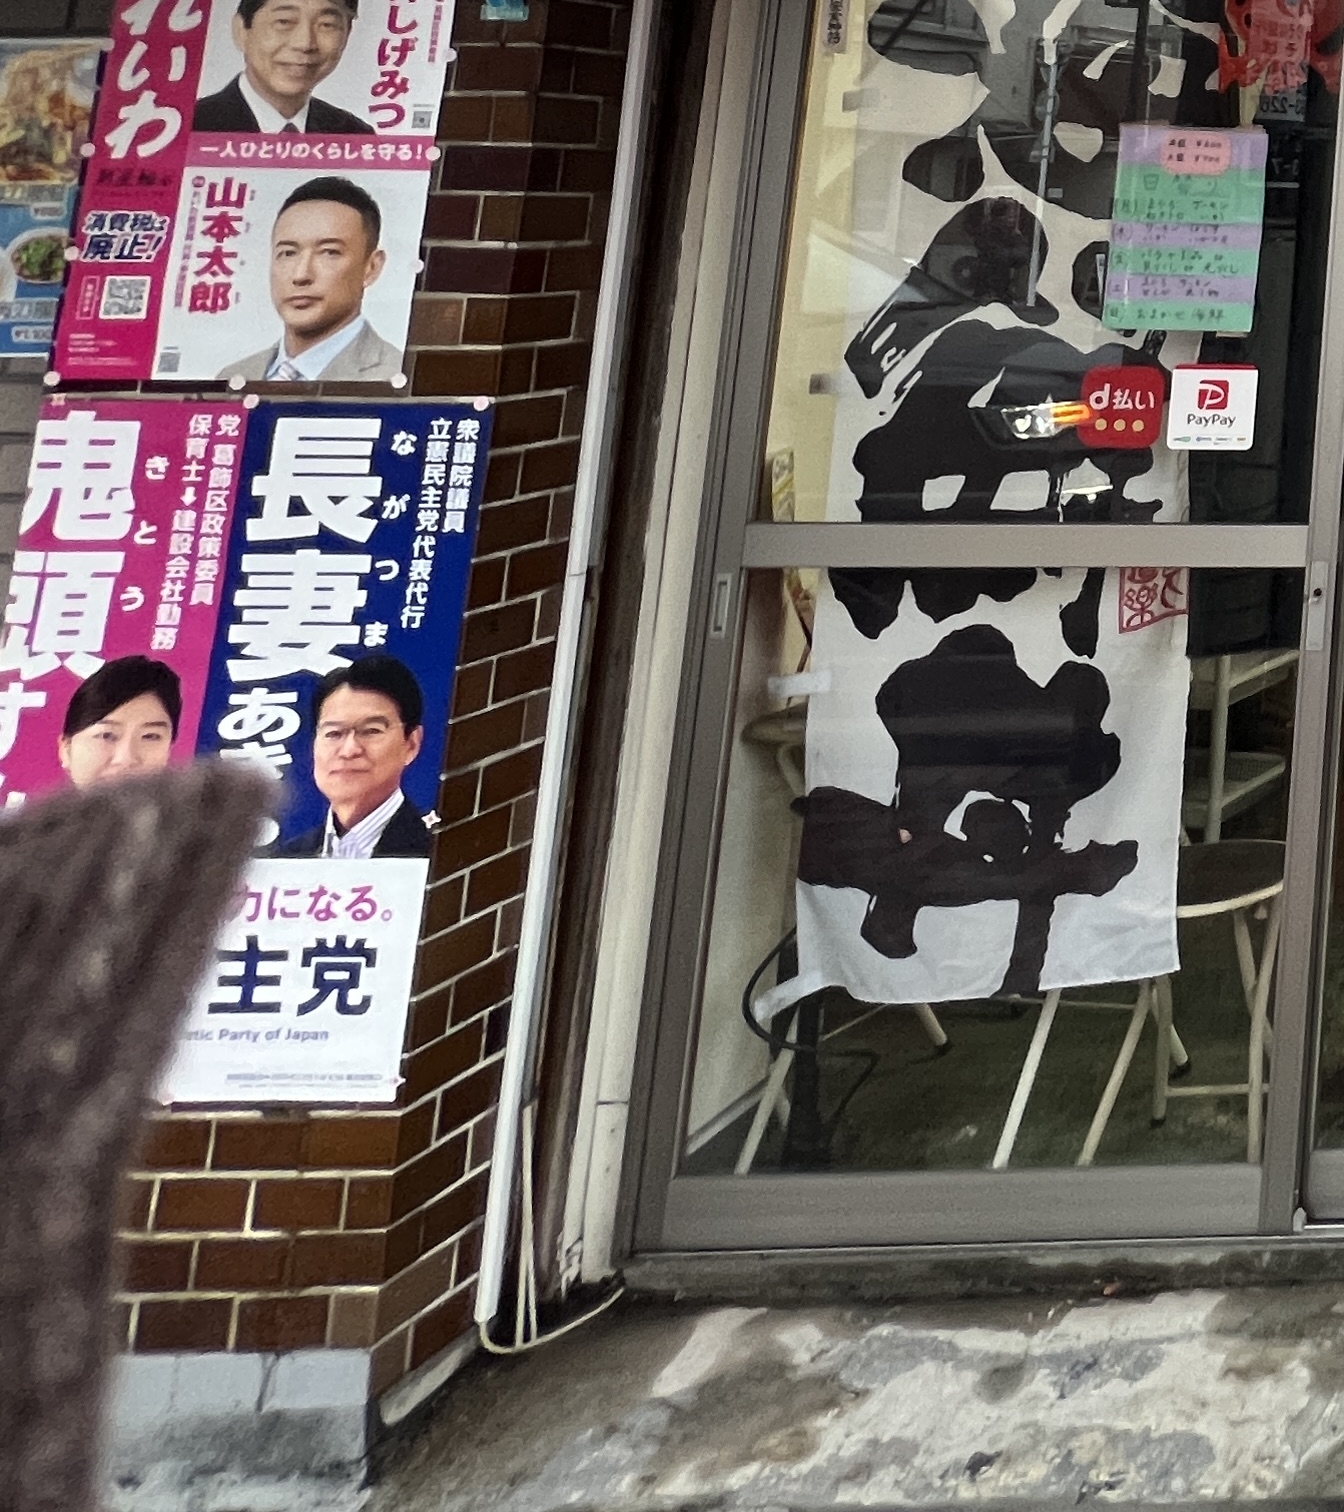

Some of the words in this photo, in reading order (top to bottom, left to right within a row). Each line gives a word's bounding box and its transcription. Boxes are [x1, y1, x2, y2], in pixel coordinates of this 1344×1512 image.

[188, 176, 248, 314] 山本太郎
[1089, 383, 1155, 410] d払い
[1186, 413, 1236, 428] PayPay
[181, 413, 213, 482] 保育士
[442, 419, 479, 534] 衆議院議員
[363, 430, 417, 648] ながつま
[401, 535, 436, 629] 代表代行
[218, 1028, 259, 1042] Party
[264, 1028, 282, 1040] of
[284, 1028, 329, 1042] Japan
